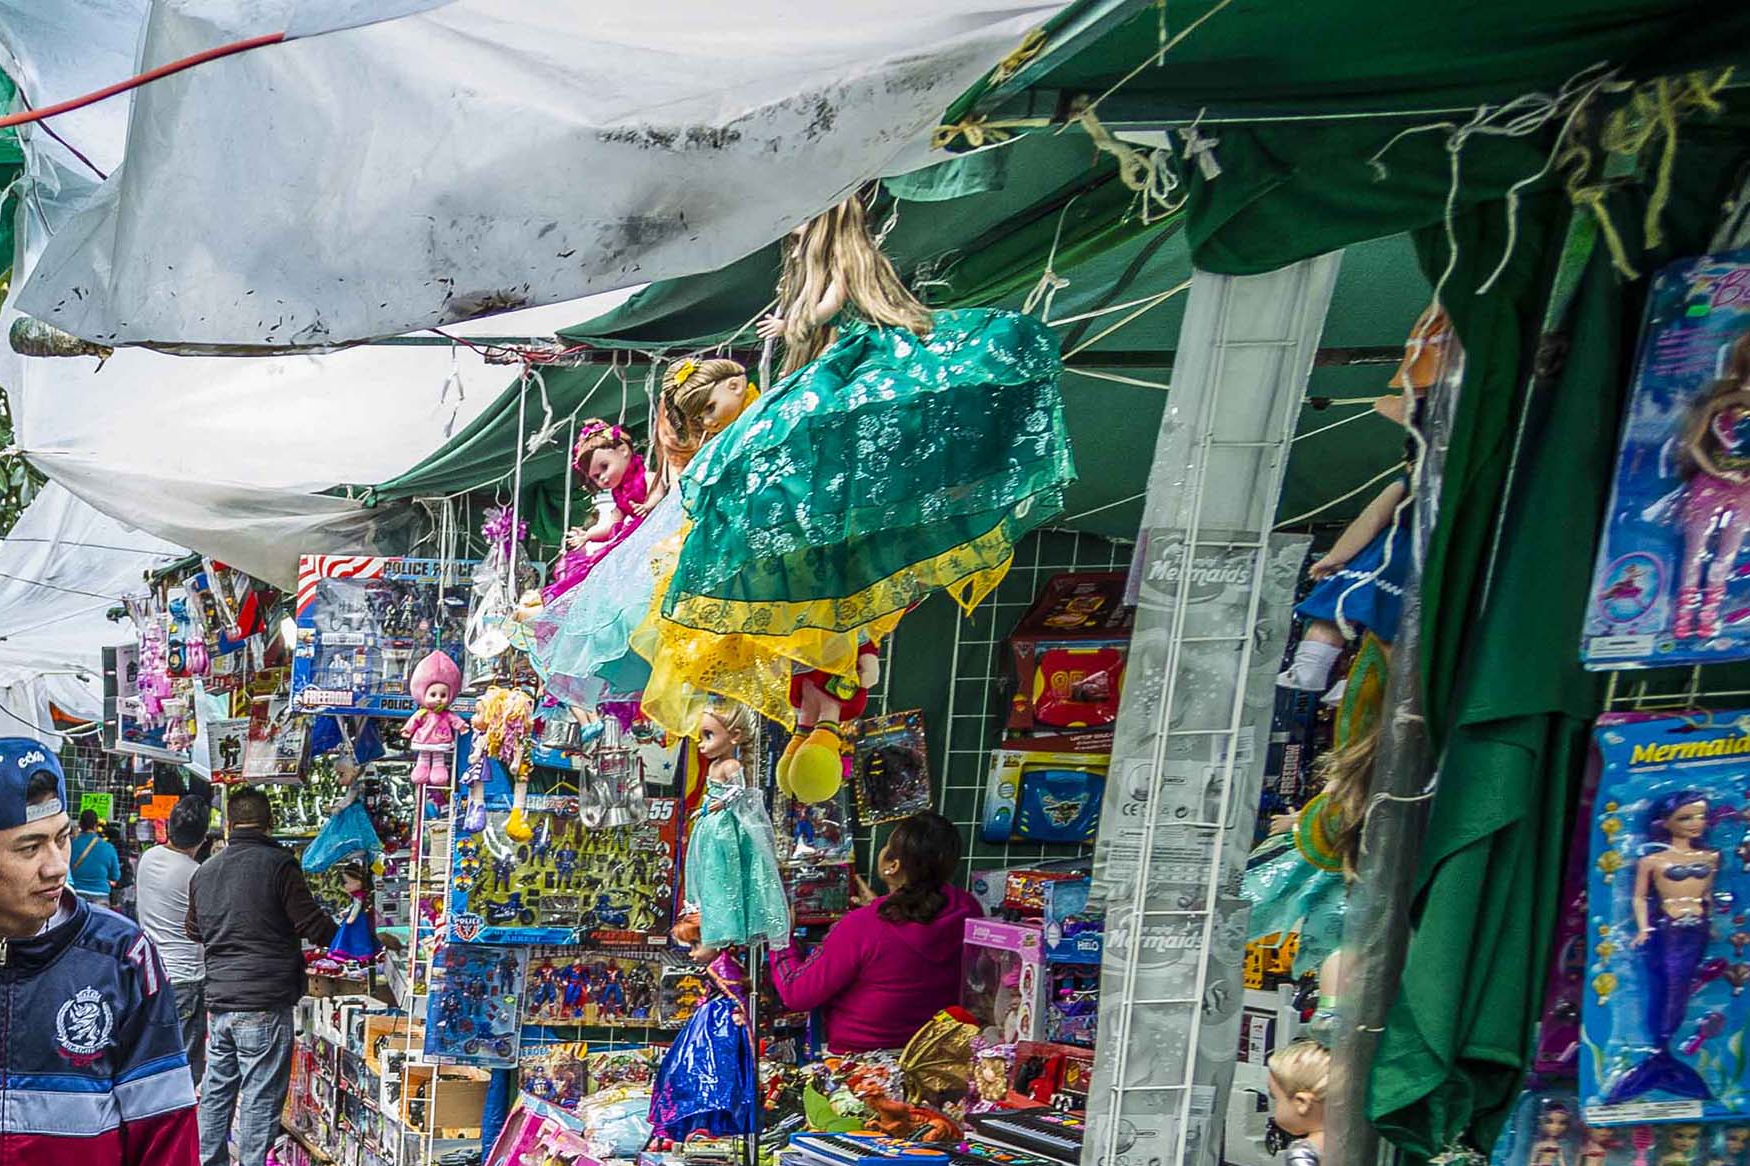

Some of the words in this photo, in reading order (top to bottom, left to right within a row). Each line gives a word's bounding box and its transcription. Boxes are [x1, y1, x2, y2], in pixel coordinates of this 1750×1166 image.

[383, 561, 428, 575] POLICE
[432, 562, 473, 575] FCE
[381, 699, 413, 710] POLICE
[1279, 744, 1301, 795] FREEDOM
[649, 801, 674, 820] 55
